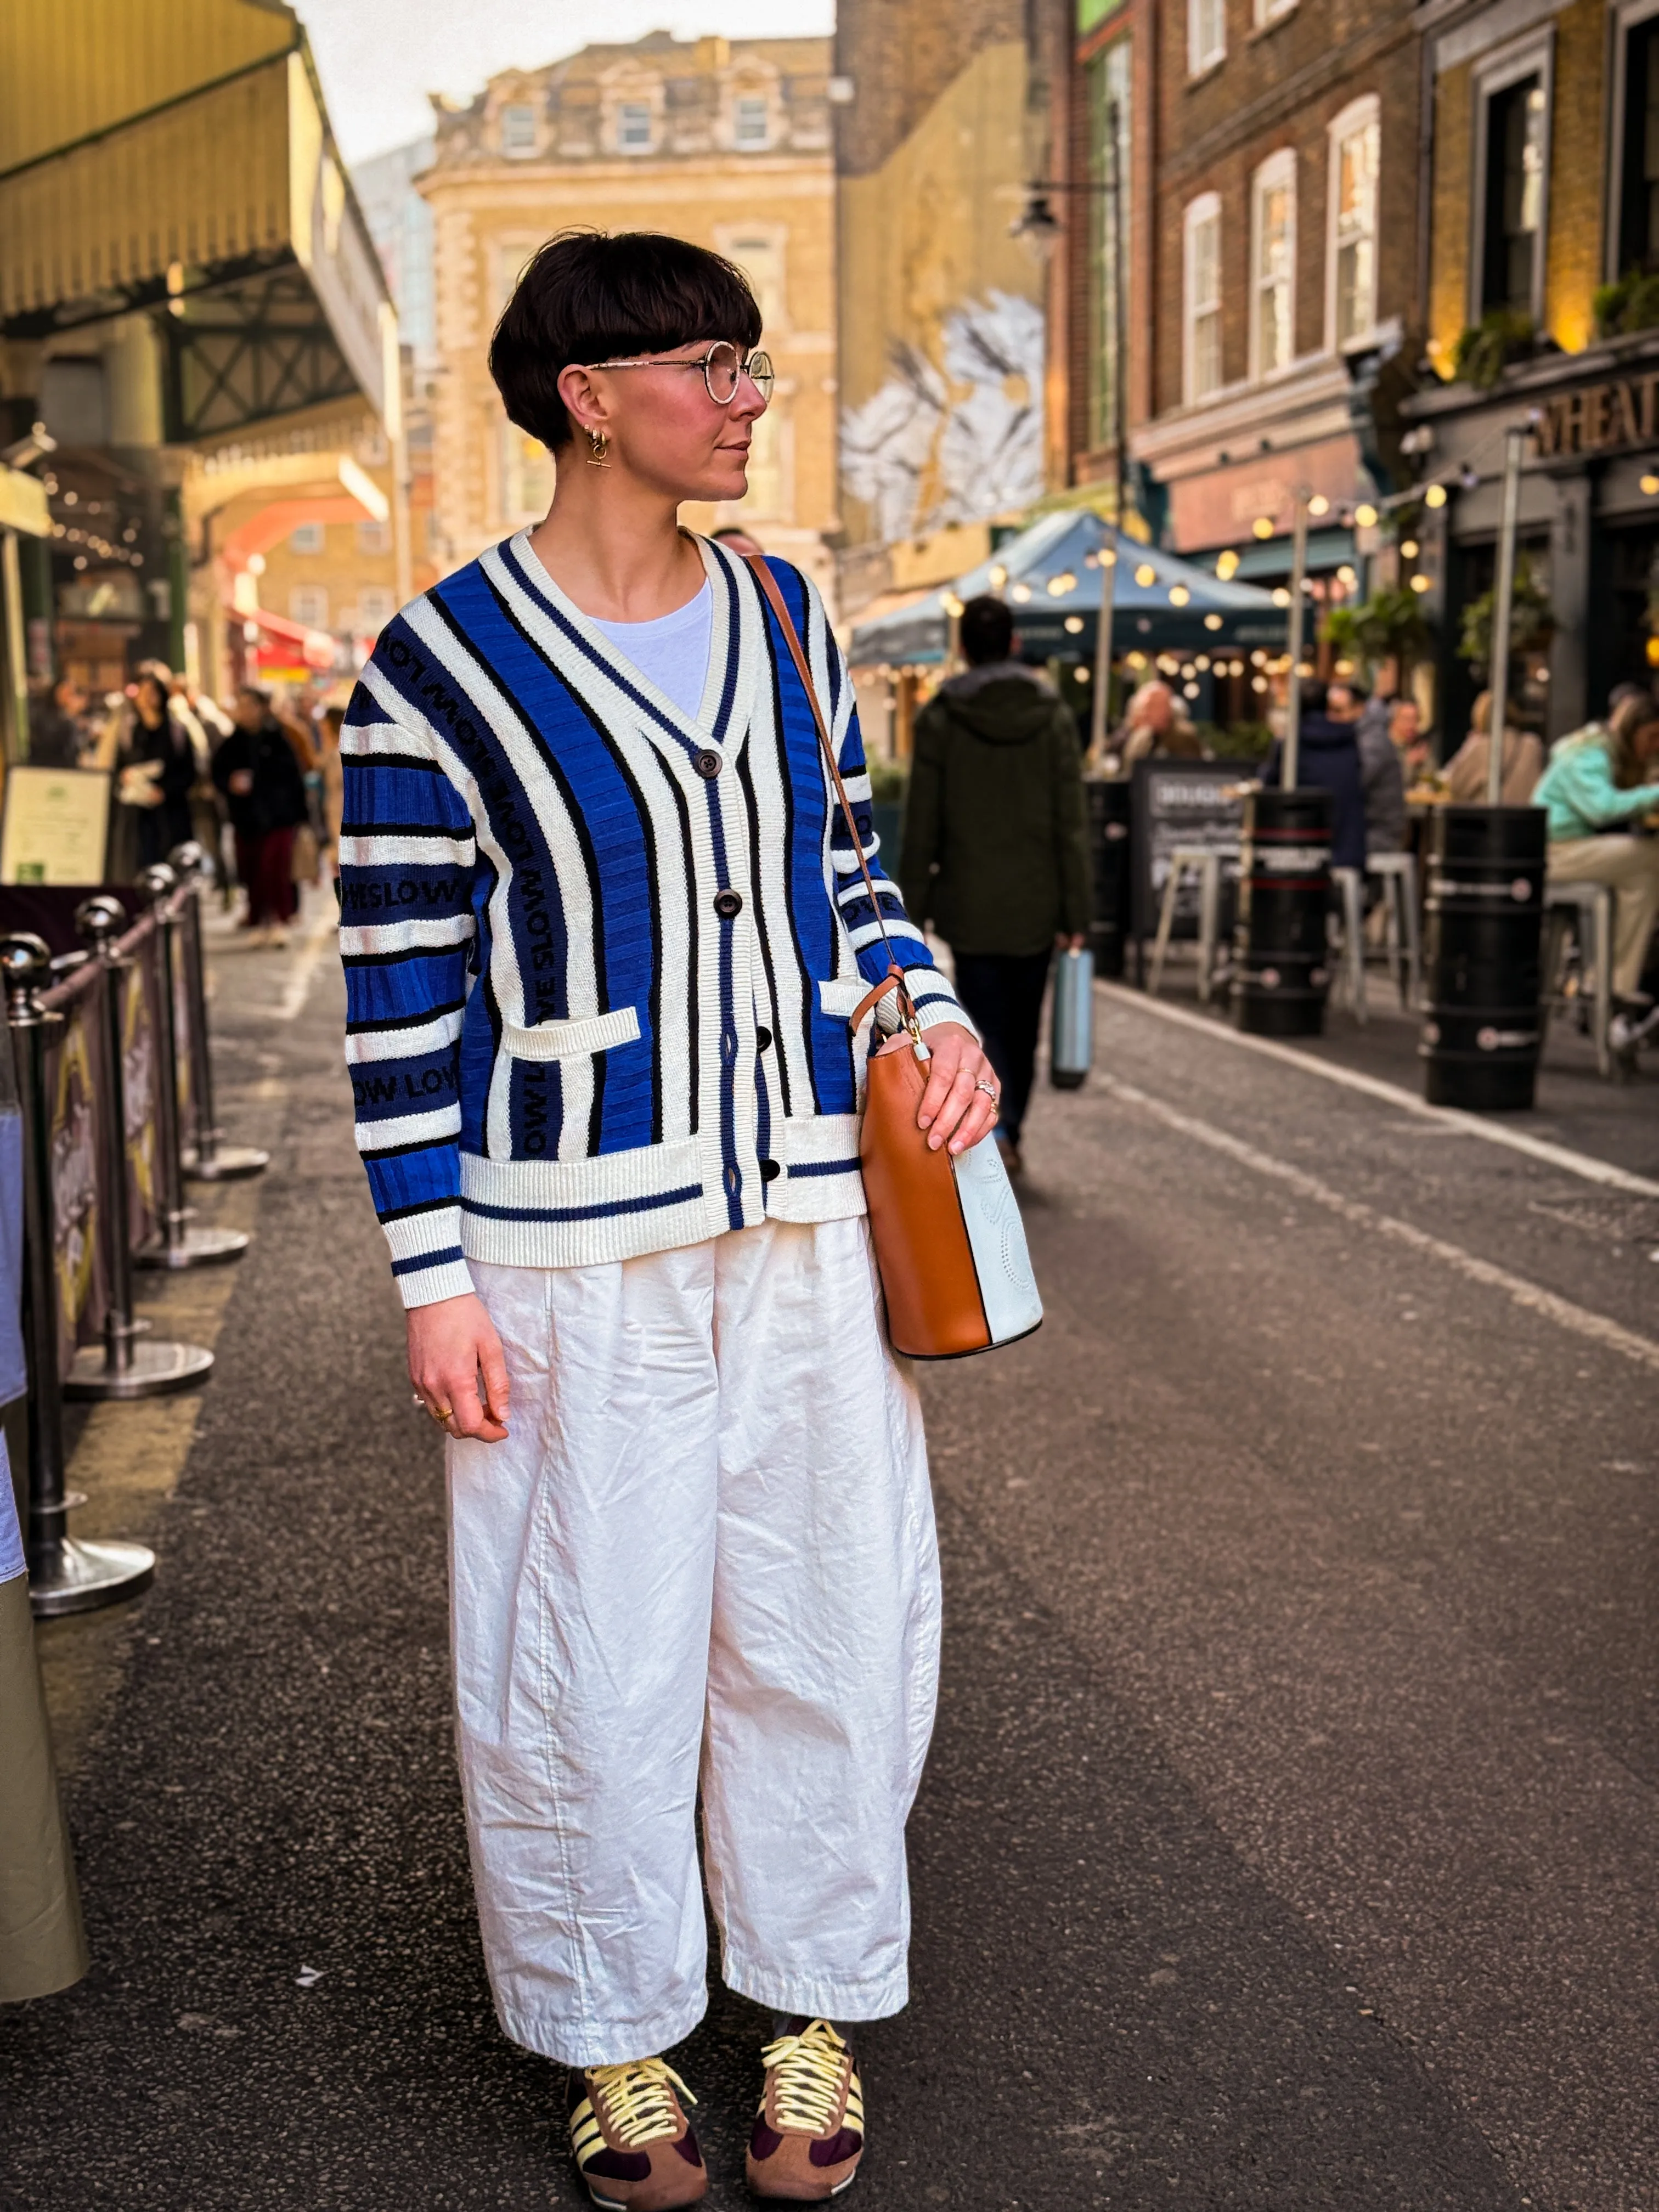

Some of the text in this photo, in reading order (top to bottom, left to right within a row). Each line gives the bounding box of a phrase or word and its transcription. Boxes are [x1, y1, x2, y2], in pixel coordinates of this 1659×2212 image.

[421, 684, 497, 778] SLOW
[489, 780, 534, 862] LOVE
[518, 870, 554, 970] SLOW
